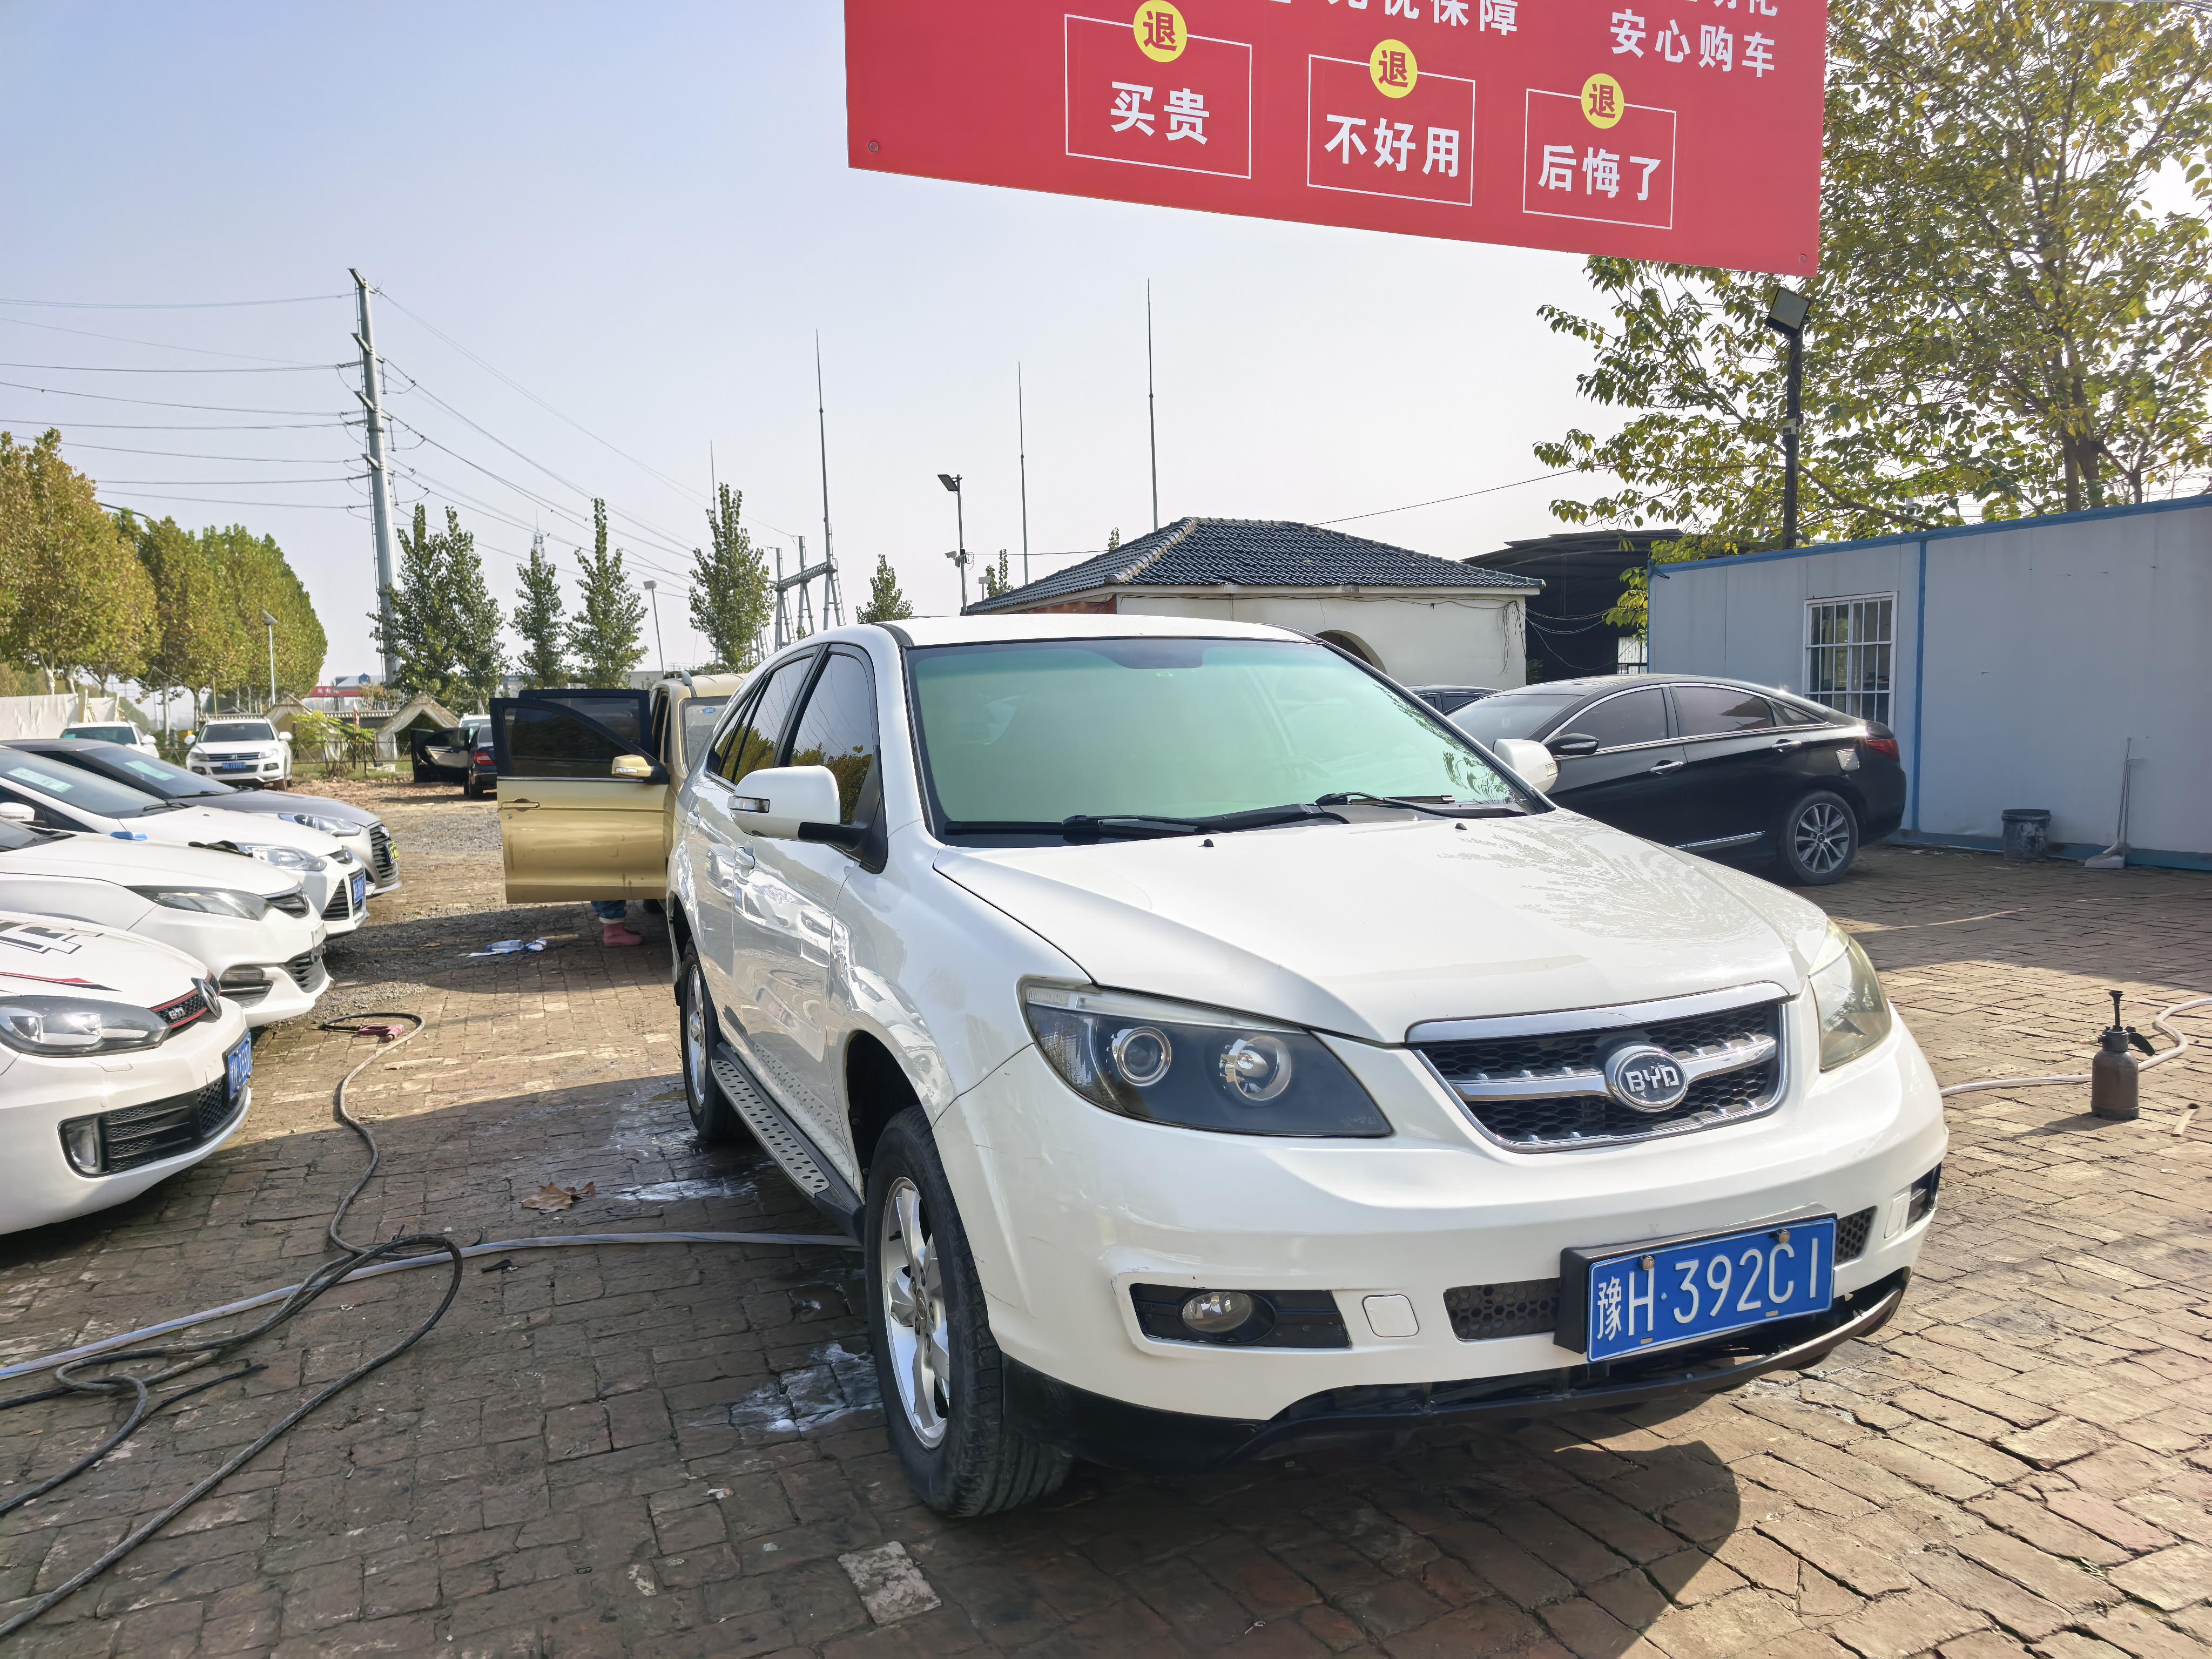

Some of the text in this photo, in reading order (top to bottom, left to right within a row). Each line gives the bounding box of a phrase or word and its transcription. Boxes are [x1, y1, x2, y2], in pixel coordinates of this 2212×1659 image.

[1143, 11, 1177, 51] 退
[1610, 9, 1775, 78] 安心购车
[1378, 50, 1408, 87] 退
[1110, 81, 1210, 145] 买贵
[1589, 84, 1616, 119] 退
[1325, 114, 1459, 177] 不好用
[1538, 145, 1661, 201] 后悔了
[1624, 1065, 1679, 1092] BYD
